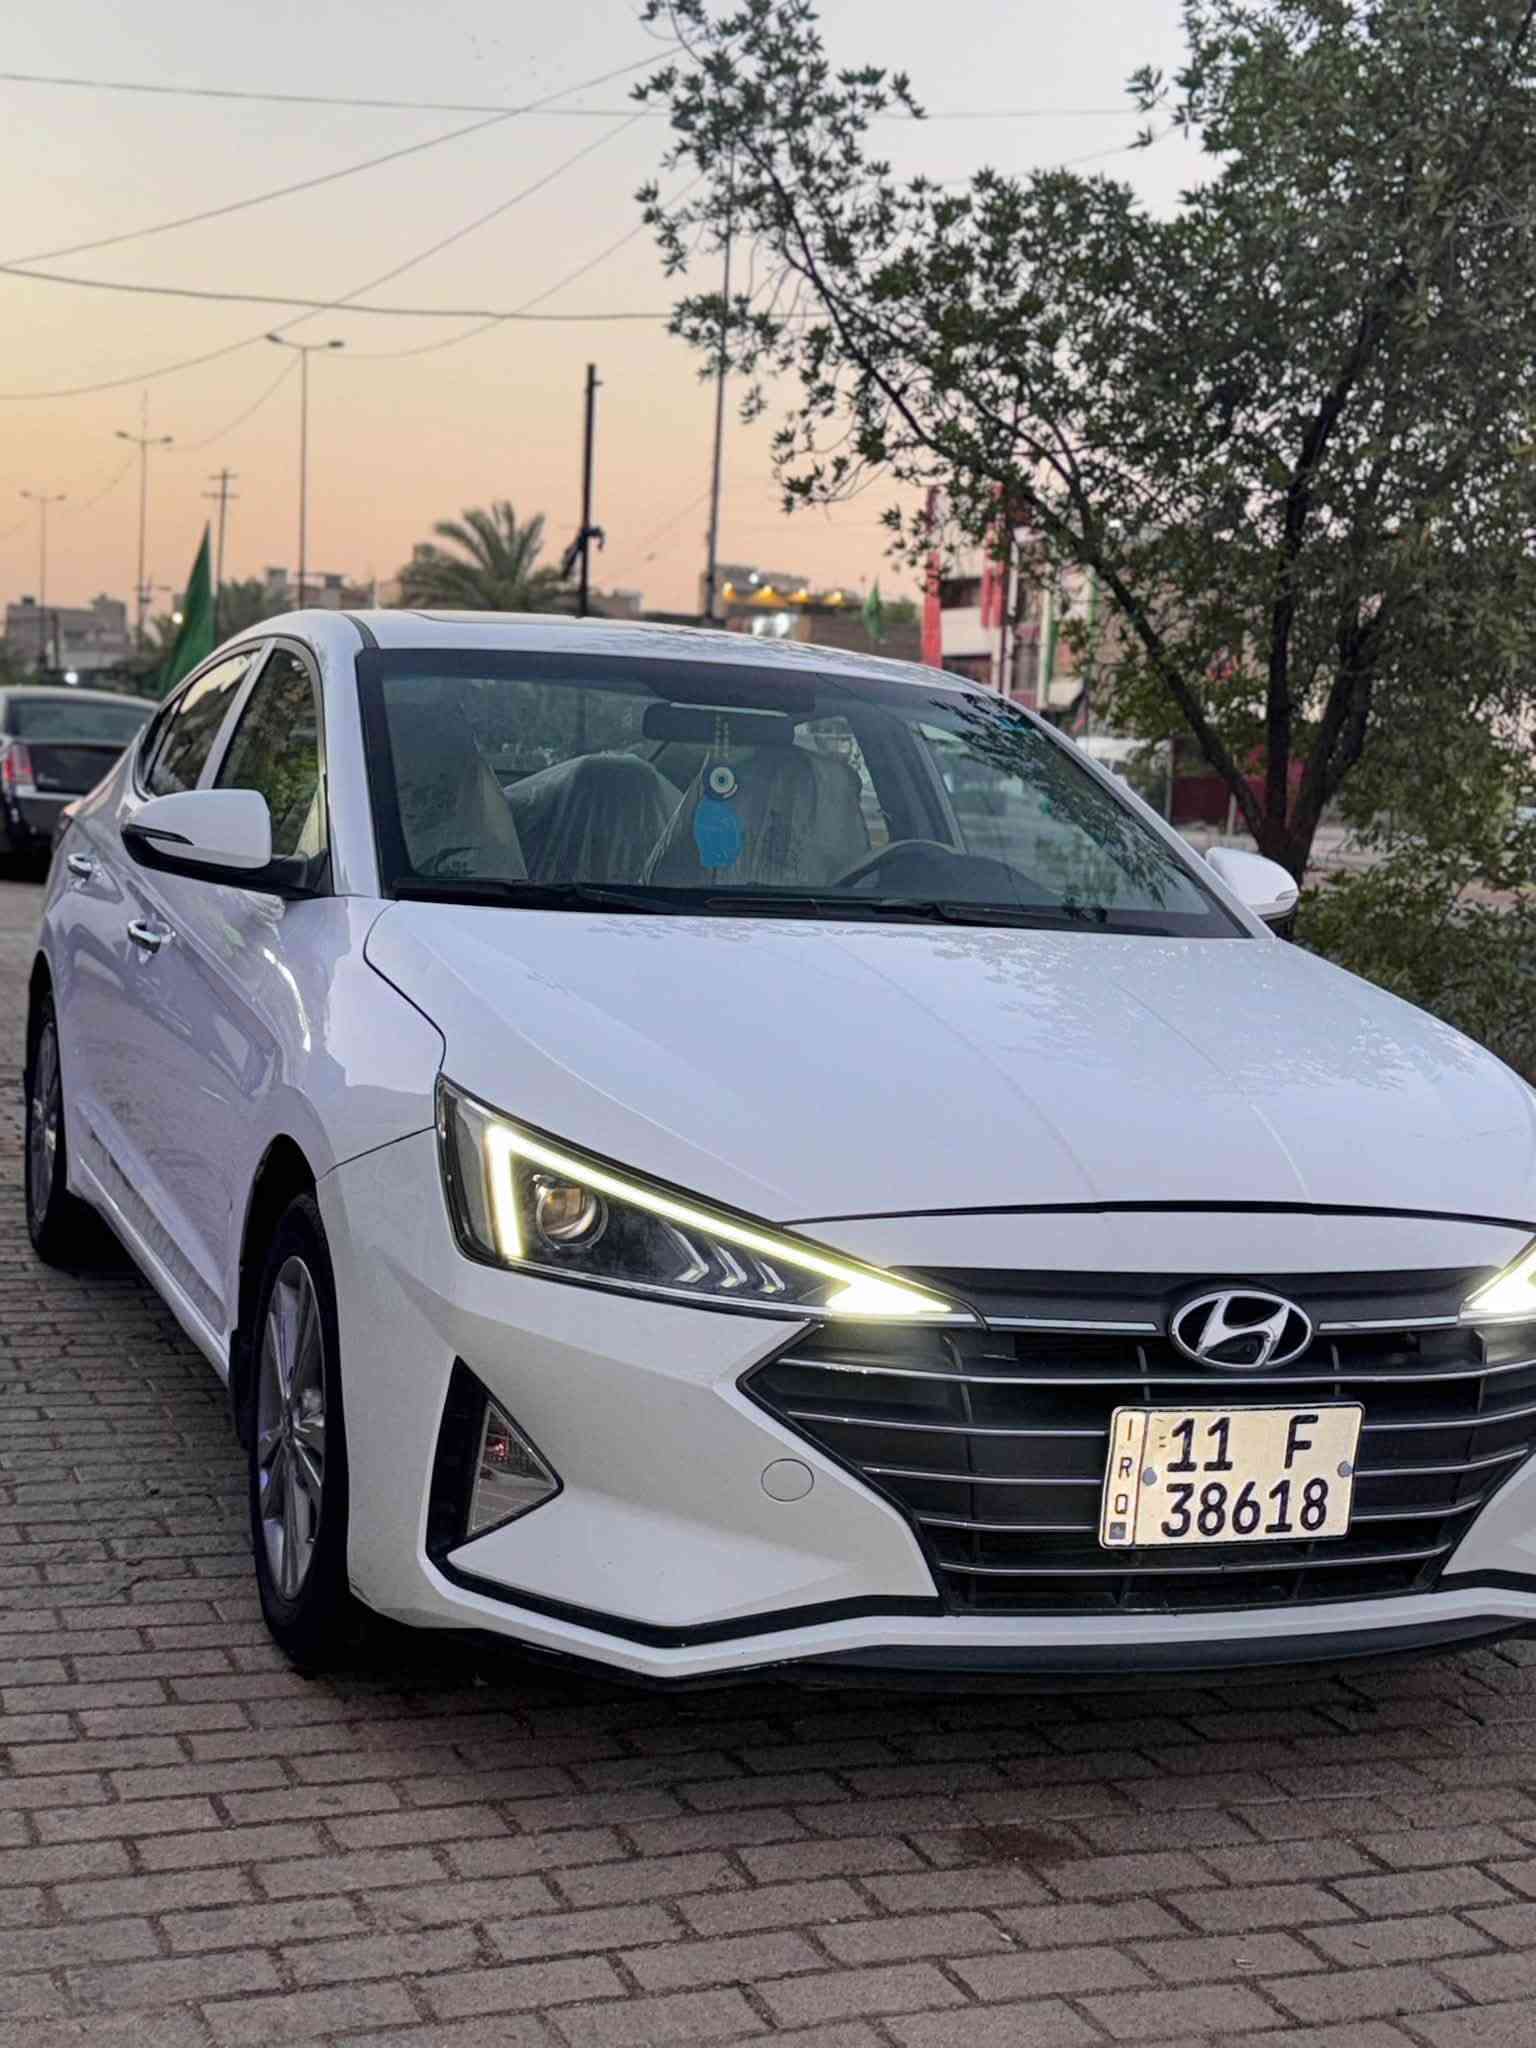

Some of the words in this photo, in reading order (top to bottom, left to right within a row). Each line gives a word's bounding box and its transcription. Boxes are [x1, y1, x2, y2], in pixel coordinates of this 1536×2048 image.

[1167, 1417, 1233, 1472] 11
[1284, 1414, 1319, 1470] F
[1161, 1478, 1329, 1538] 38618
